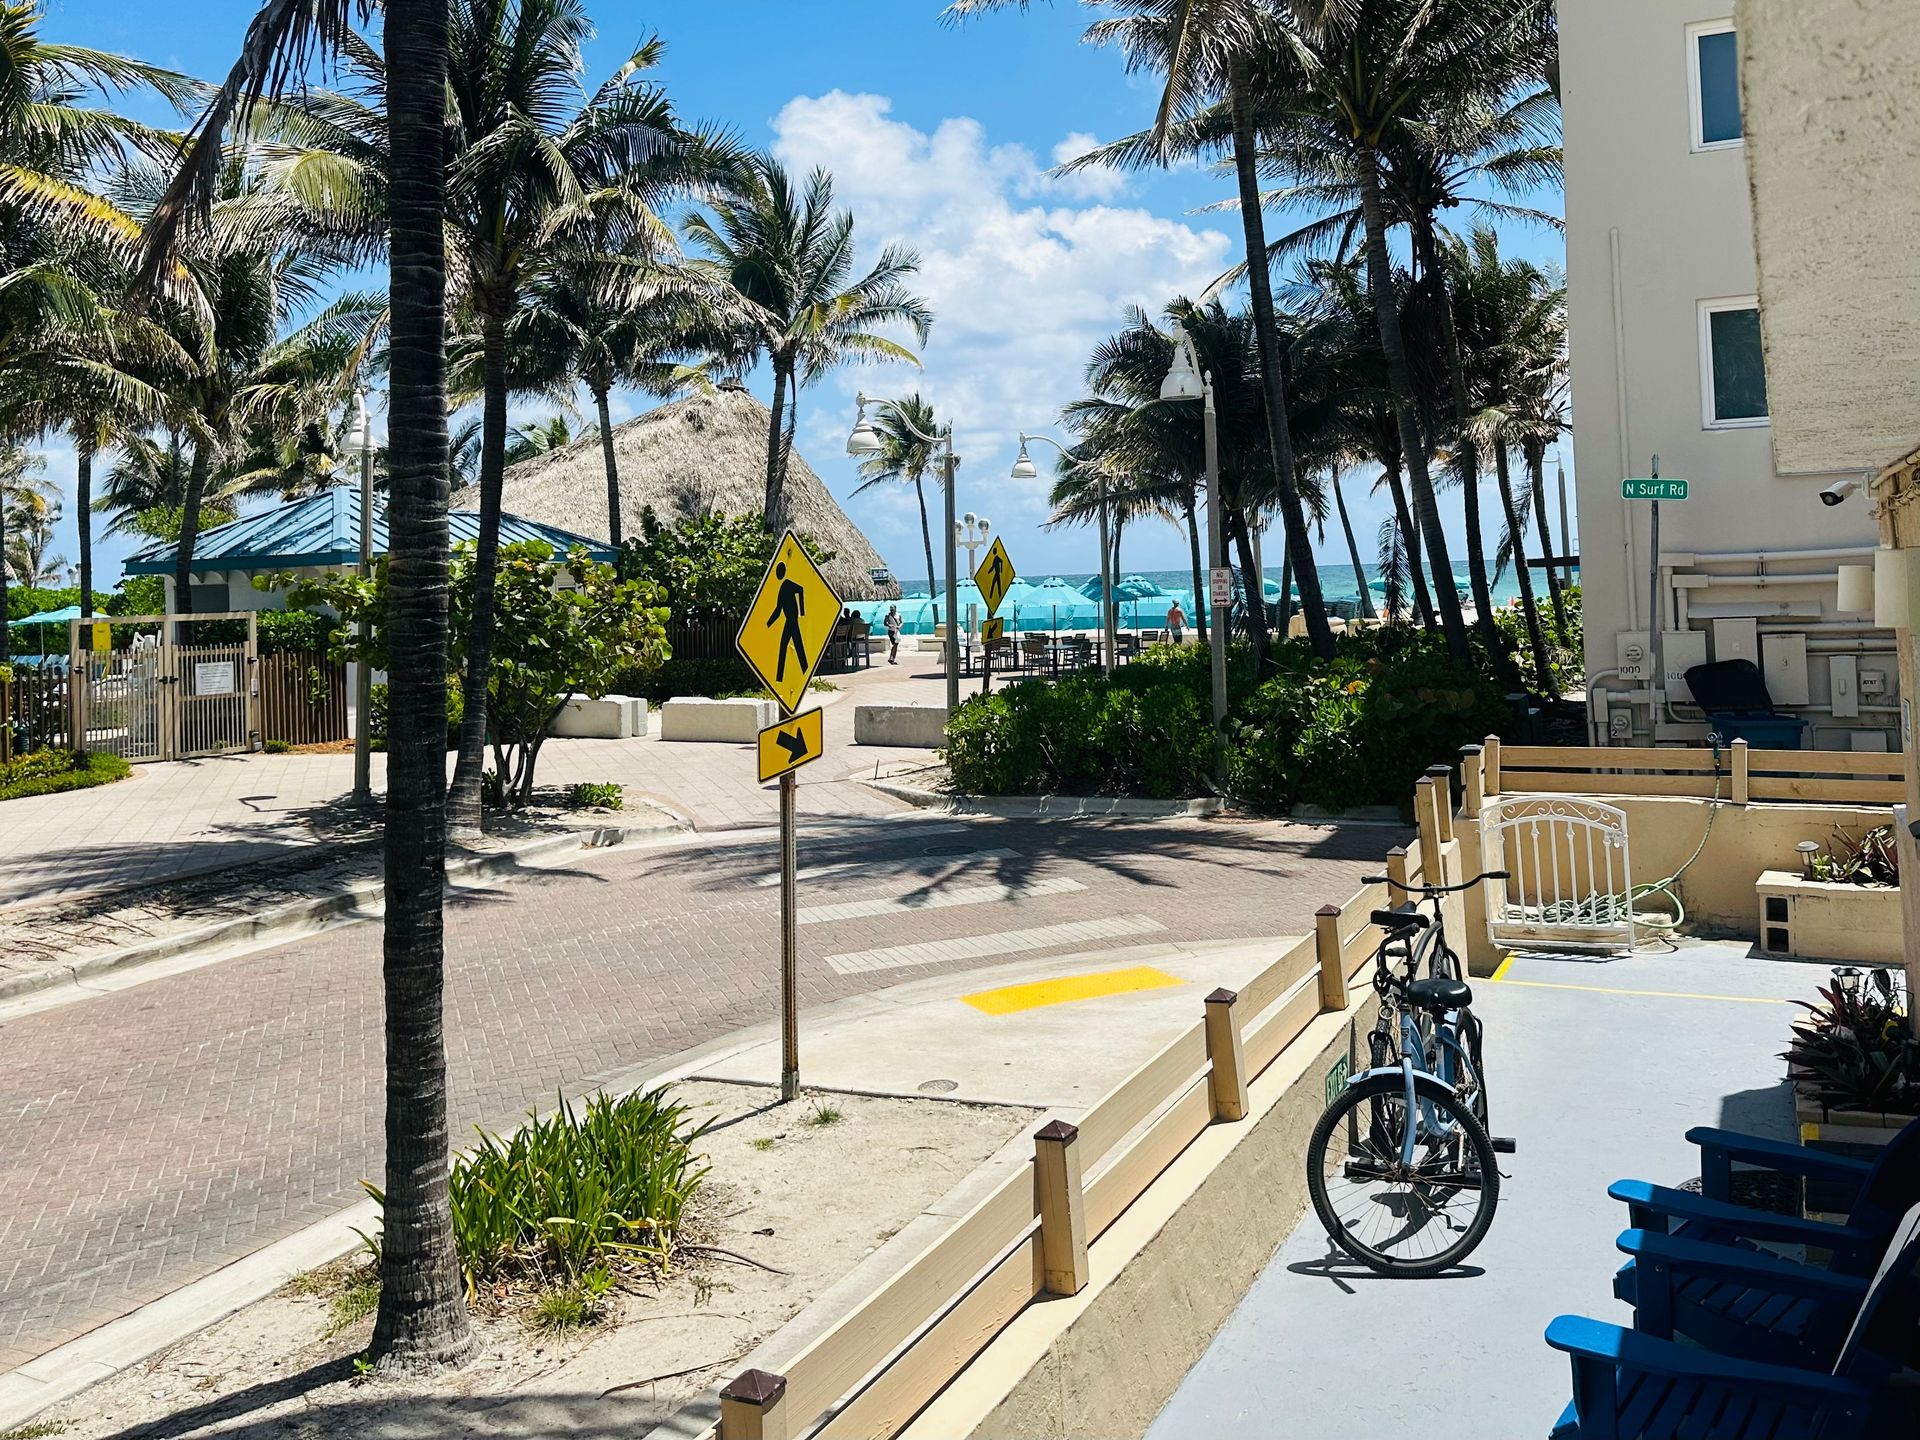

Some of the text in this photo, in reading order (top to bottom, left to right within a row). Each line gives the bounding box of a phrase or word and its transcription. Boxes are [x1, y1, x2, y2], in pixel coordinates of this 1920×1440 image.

[1626, 483, 1684, 496] N Surf Rd
[1620, 665, 1641, 674] 1000
[1611, 729, 1618, 737] 2
